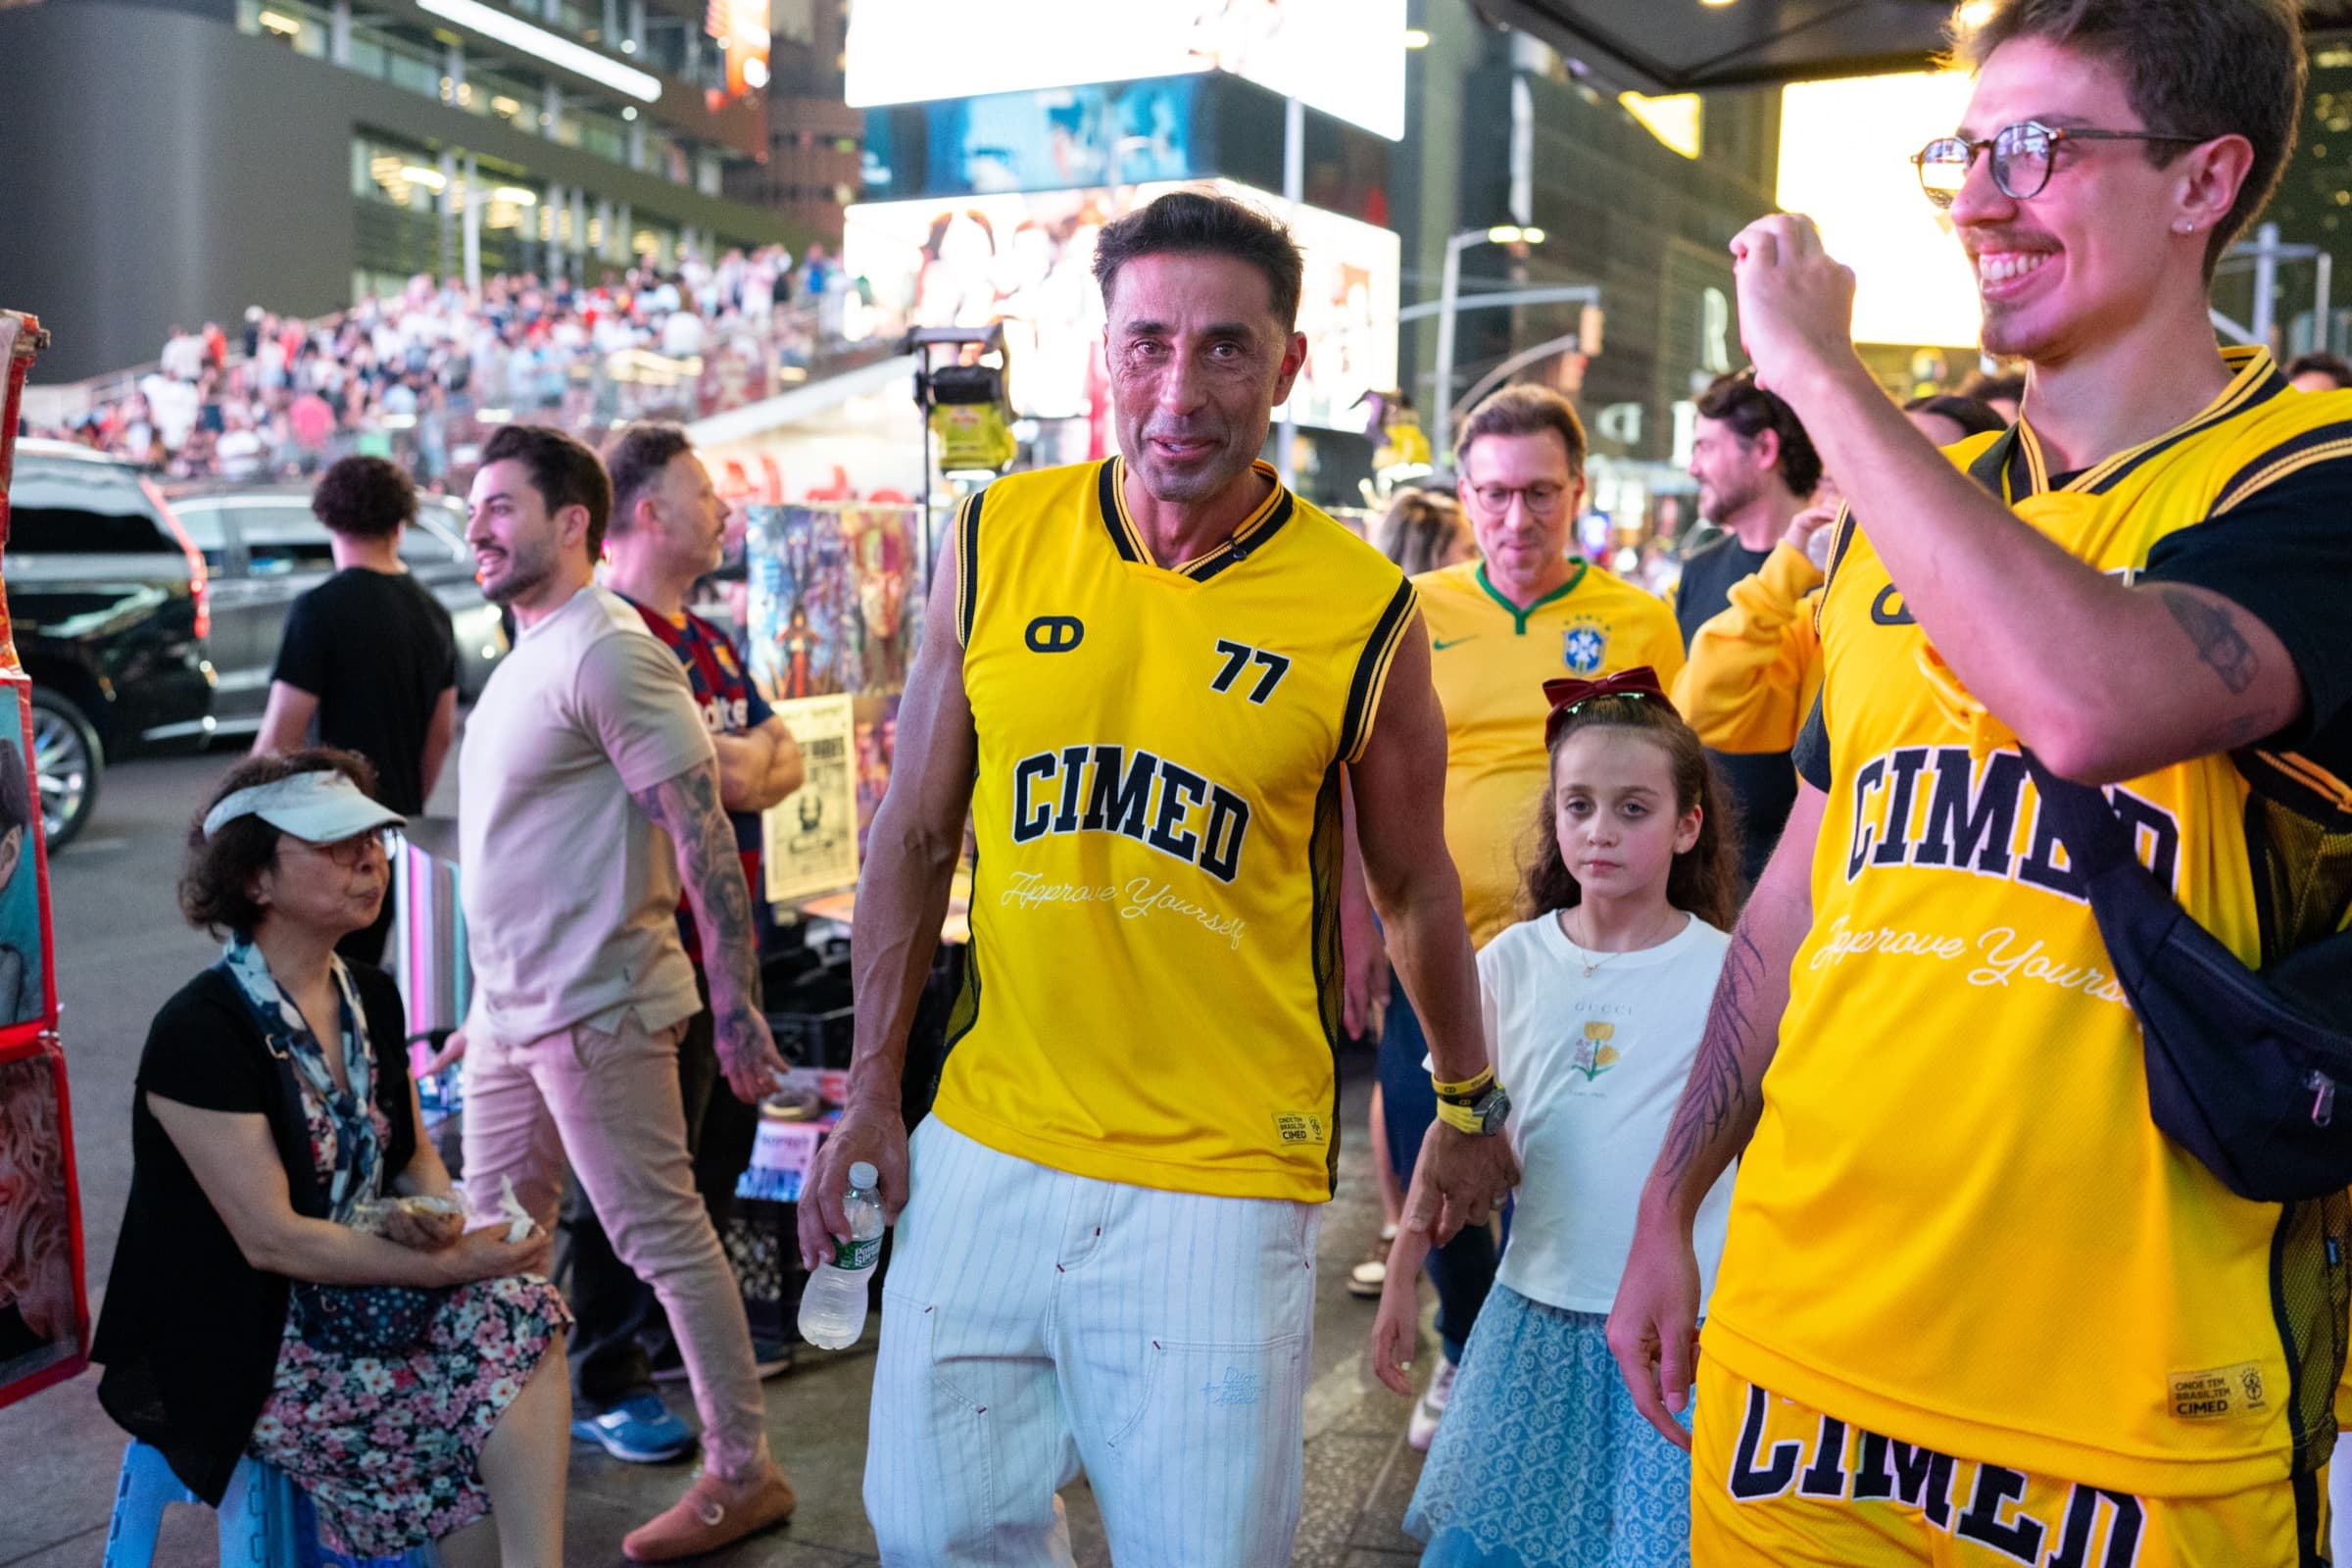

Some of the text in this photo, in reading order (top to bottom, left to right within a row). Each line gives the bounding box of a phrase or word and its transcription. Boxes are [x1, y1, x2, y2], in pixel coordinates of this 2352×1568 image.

[1210, 638, 1291, 706] 77
[1012, 745, 1250, 884] CIMED
[1001, 870, 1246, 950] Approve Yourself
[1967, 926, 2132, 1010] Yours
[2176, 1377, 2225, 1391] ONDE TEM
[2177, 1399, 2228, 1414] CIMED
